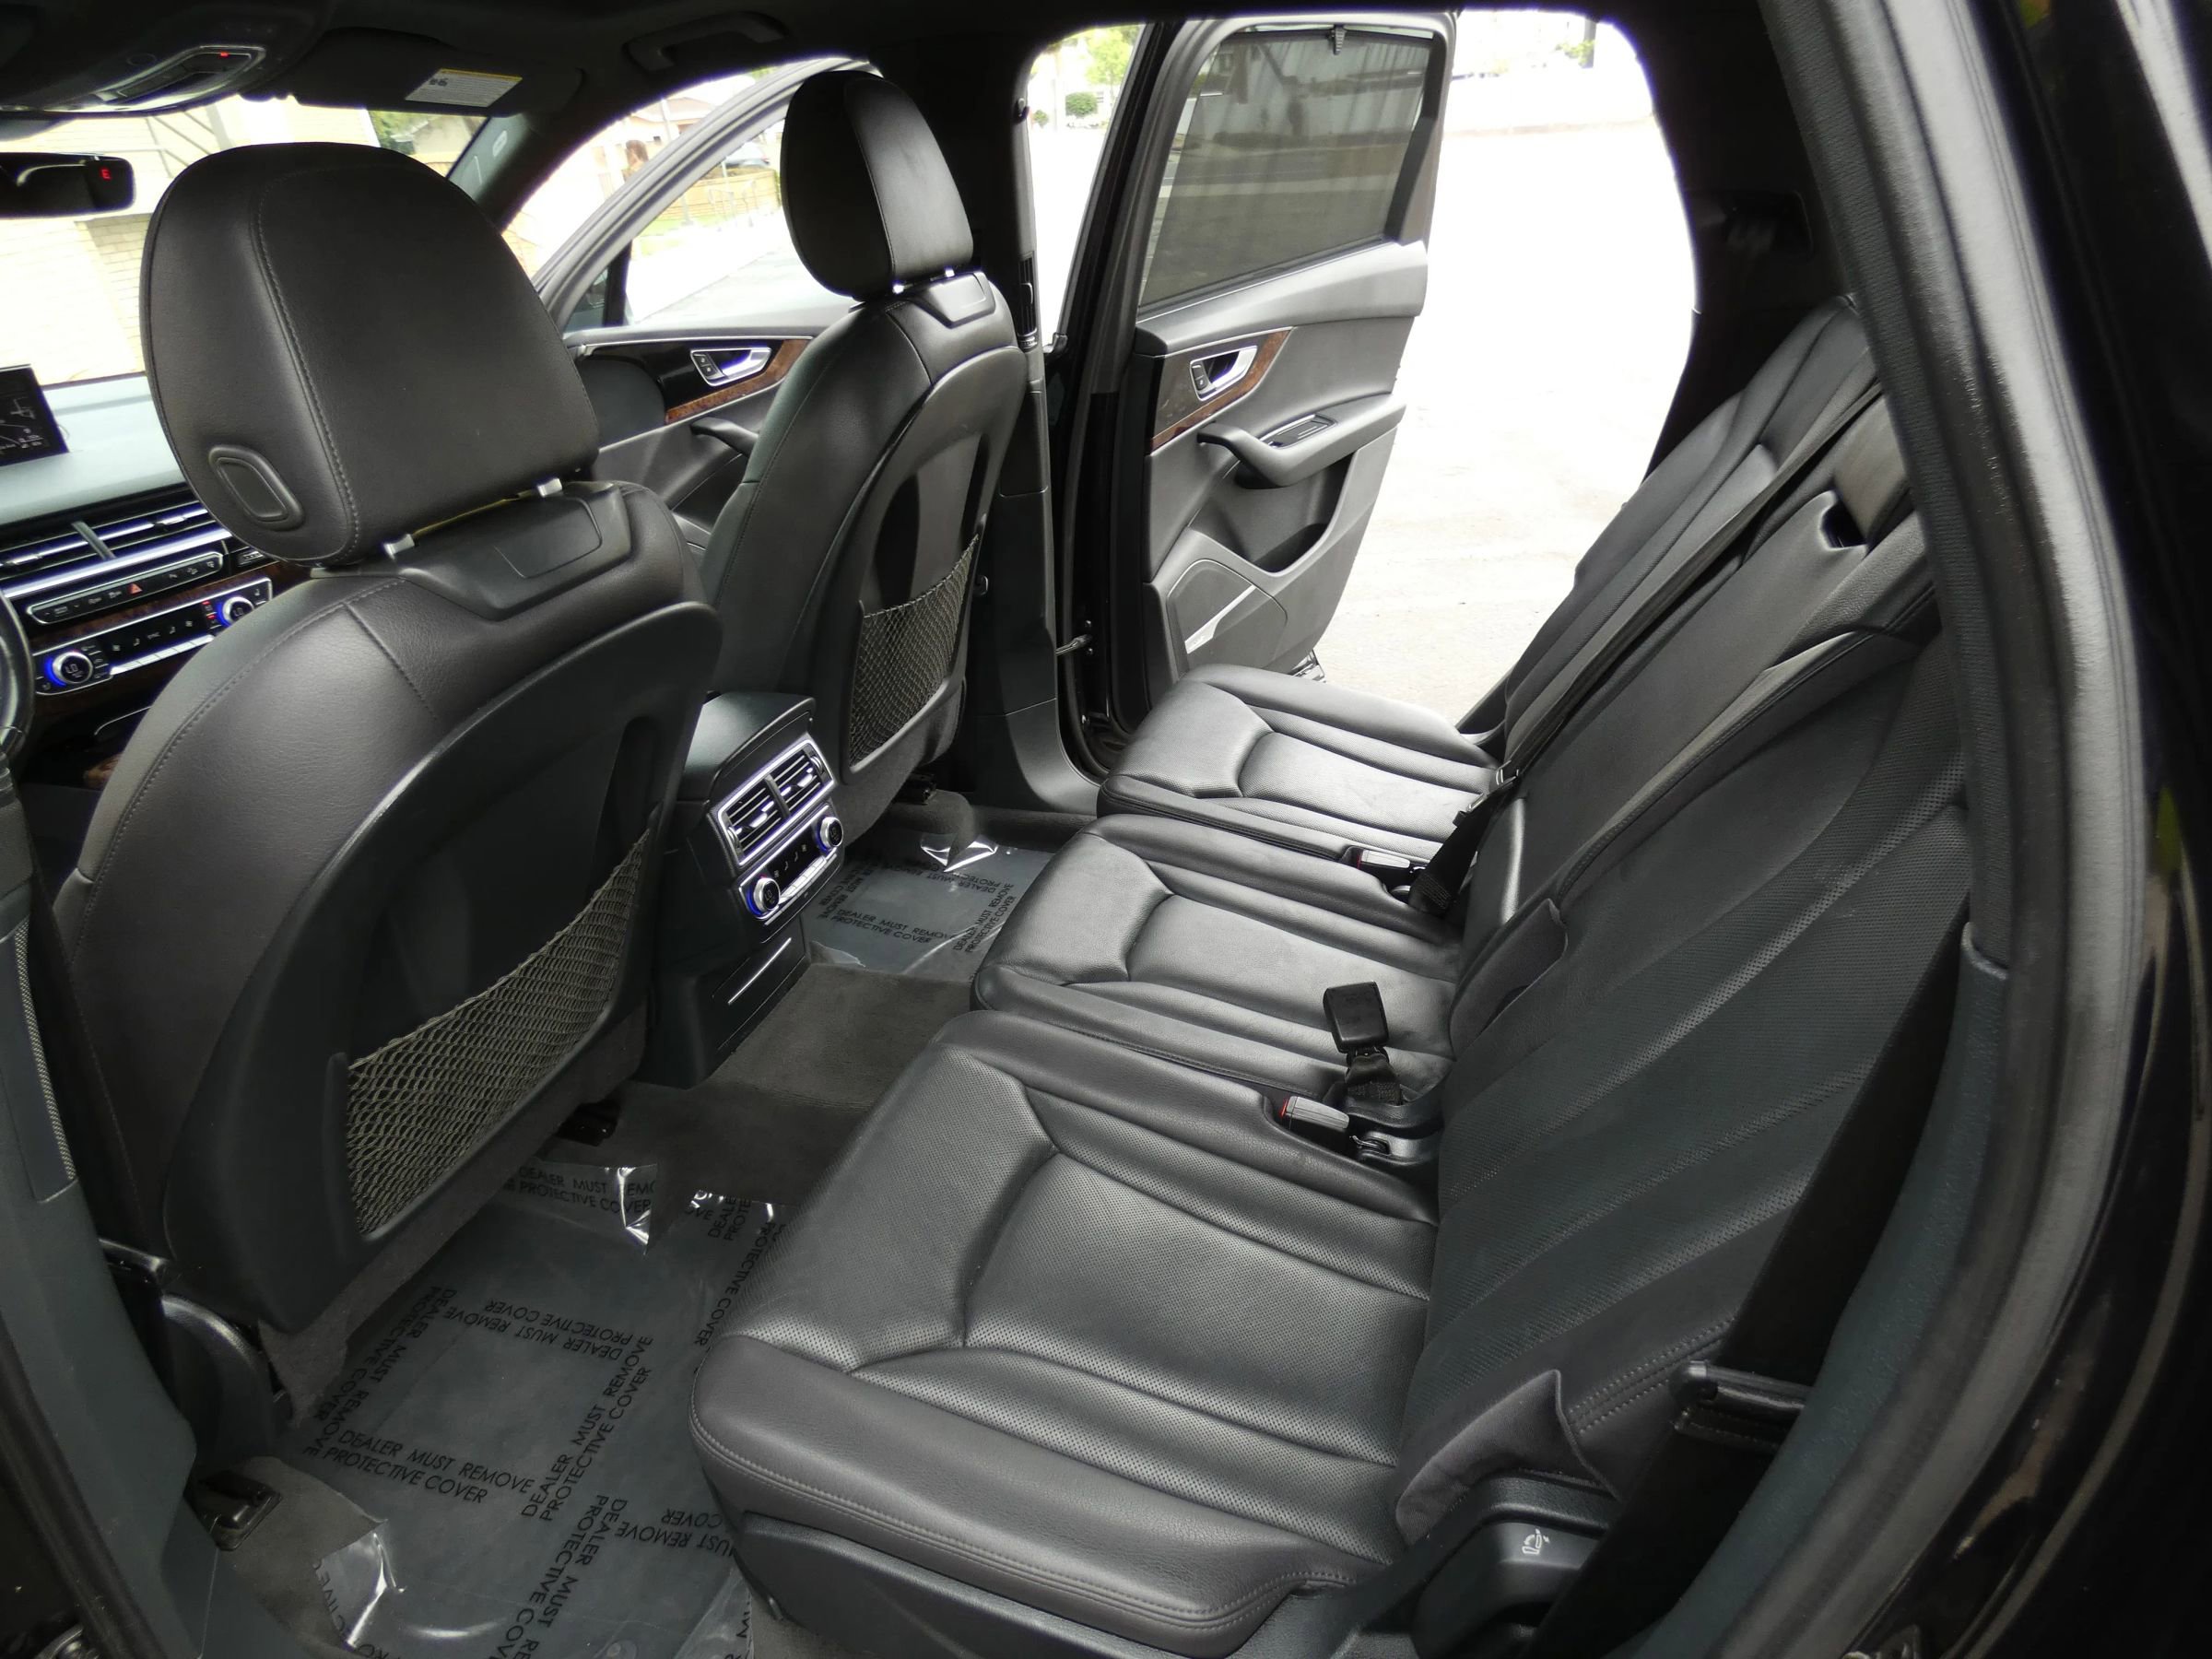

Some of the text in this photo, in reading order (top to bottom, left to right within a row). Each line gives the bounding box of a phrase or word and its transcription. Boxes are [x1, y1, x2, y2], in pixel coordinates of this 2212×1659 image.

[830, 916, 932, 943] PROTECTIVE COVER
[837, 909, 877, 922] DEALER
[879, 919, 909, 930] MUST
[519, 1181, 596, 1208] PROTECTIVE
[573, 1179, 607, 1194] MUST
[707, 1195, 737, 1238] DEALE
[443, 1306, 623, 1360] DEALER MUST REMOVE
[485, 1298, 634, 1346] PROTECTIVE COVER
[302, 1288, 458, 1456] DEALER MUST REMOVE
[521, 1335, 653, 1518] DEALER MUST REMOVE
[539, 1366, 652, 1522] PROTECTIVE COVER
[324, 1446, 488, 1504] PROTECTIVE COVER
[338, 1430, 535, 1494] DEALER MUST REMOVE
[614, 1521, 693, 1548] REMOVE
[661, 1508, 723, 1529] COVER
[529, 1494, 609, 1606] PROTECTIVE
[536, 1497, 629, 1629] DEALER MUST
